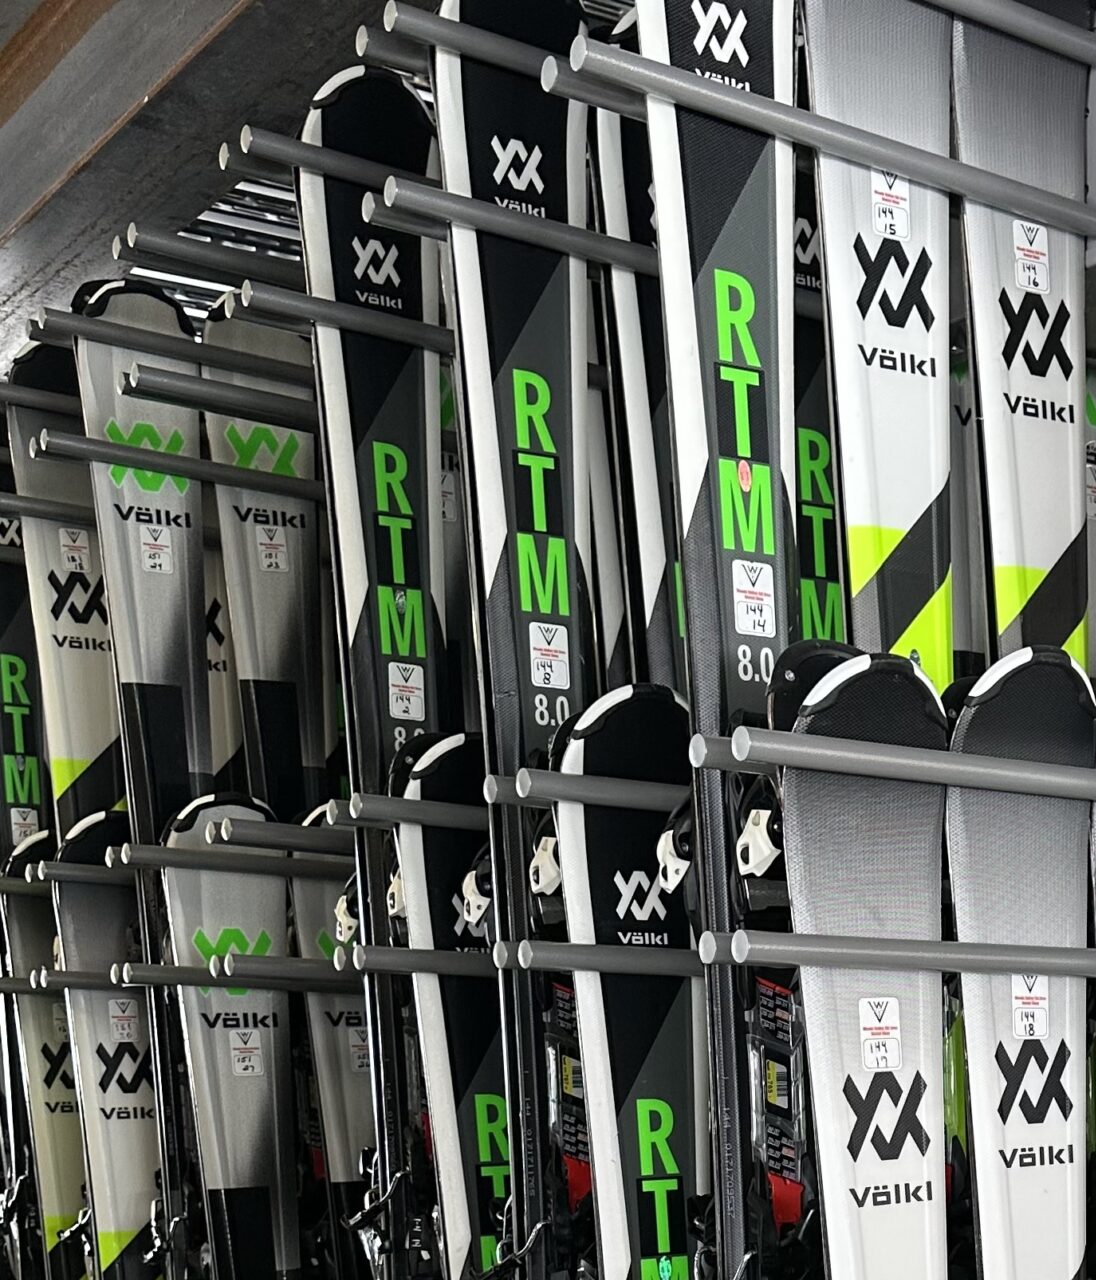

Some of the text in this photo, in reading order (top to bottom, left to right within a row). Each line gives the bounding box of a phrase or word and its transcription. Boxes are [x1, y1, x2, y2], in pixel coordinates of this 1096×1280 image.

[877, 206, 895, 220] 144
[884, 222, 897, 235] 15
[1022, 263, 1038, 276] 144
[1027, 276, 1040, 288] 16
[355, 289, 402, 310] Völkl
[858, 344, 937, 378] Völkl
[714, 268, 776, 556] RTM
[1003, 391, 1075, 424] Völkl
[512, 368, 570, 617] RTM
[114, 503, 192, 528] Völkl
[232, 505, 306, 529] Völkl
[798, 427, 844, 643] RTM
[372, 440, 428, 658] RTM
[746, 603, 764, 618] 144
[753, 619, 767, 633] 14
[536, 660, 554, 674] 144
[737, 644, 775, 684] 8.0
[543, 673, 552, 685] 8
[534, 694, 570, 727] 8.0
[1, 654, 41, 805] RTM
[617, 931, 668, 946] Völkl
[202, 1011, 279, 1029] Völkl
[1020, 1010, 1036, 1023] 144
[1023, 1023, 1036, 1036] 18
[870, 1040, 888, 1054] 144
[875, 1056, 888, 1069] 17
[101, 1106, 155, 1120] Völk
[998, 1144, 1074, 1169] Völkl
[849, 1181, 933, 1208] Völkl
